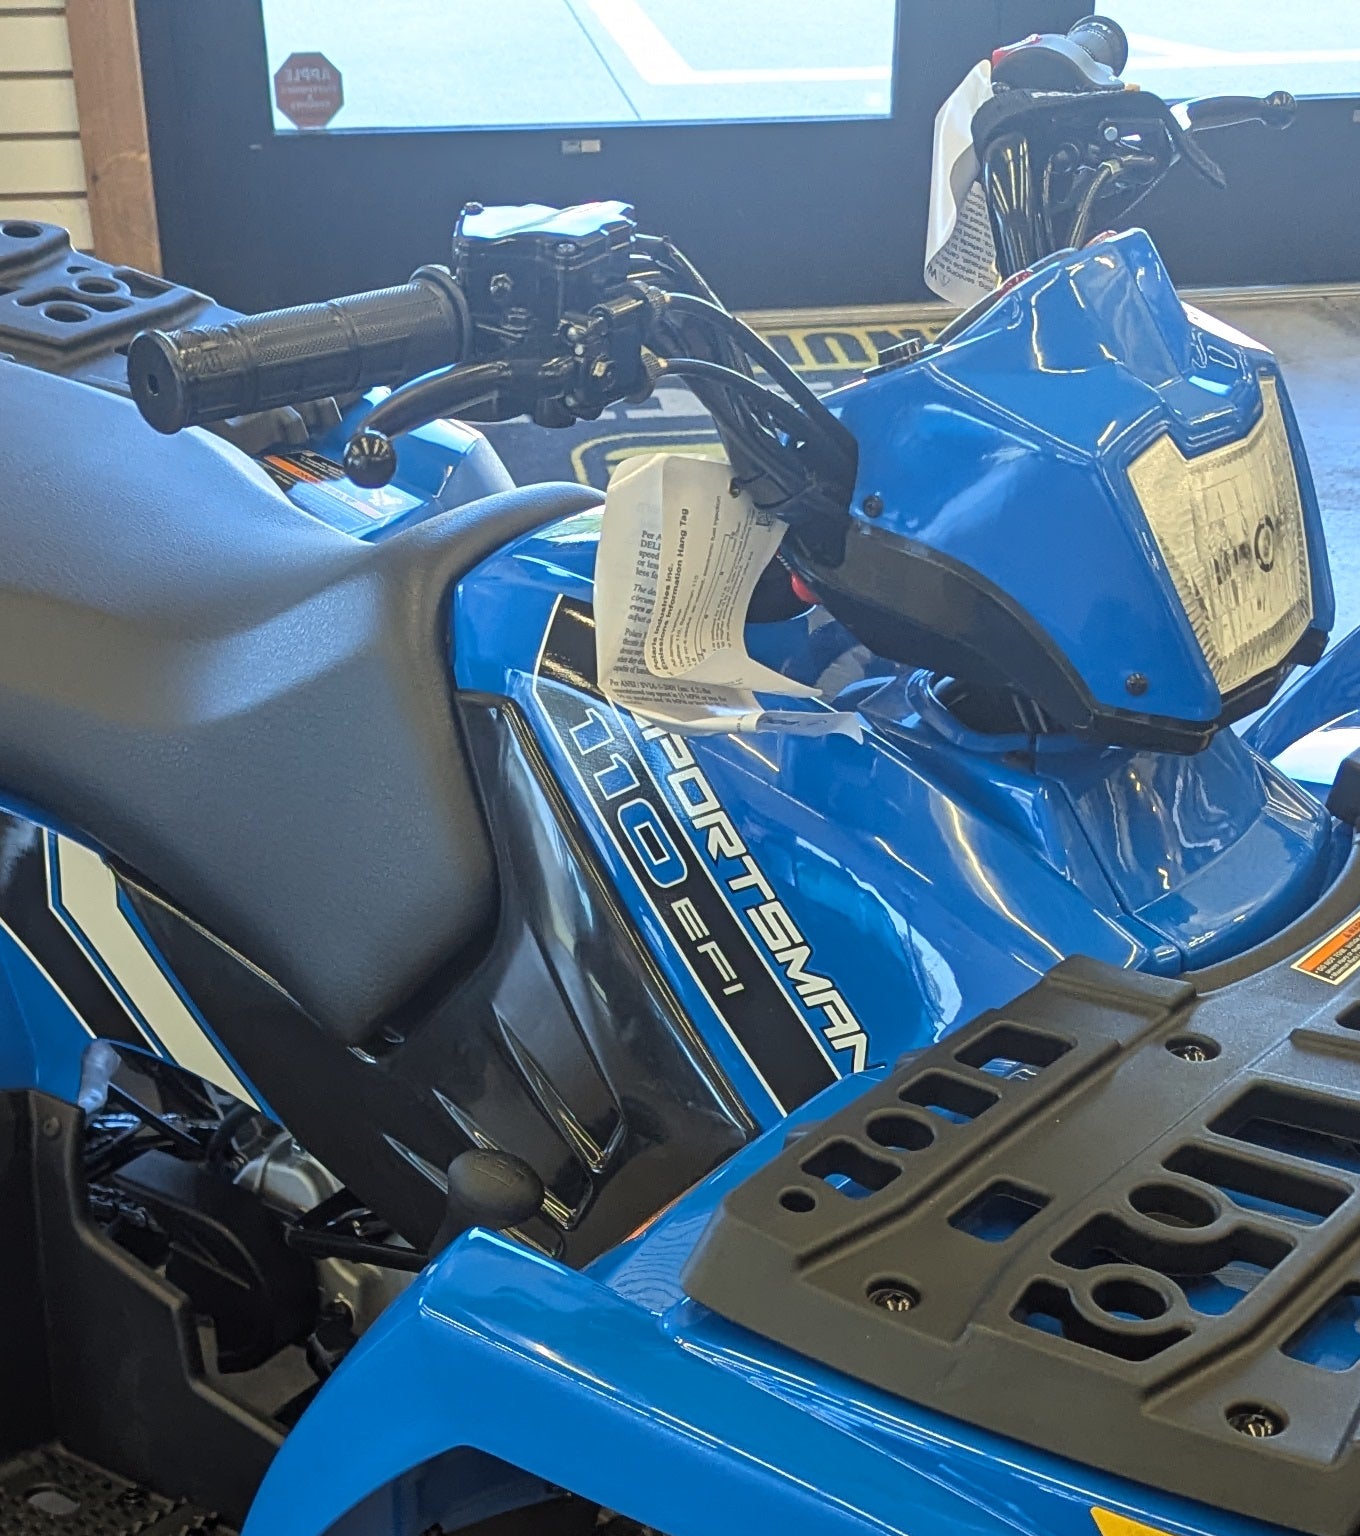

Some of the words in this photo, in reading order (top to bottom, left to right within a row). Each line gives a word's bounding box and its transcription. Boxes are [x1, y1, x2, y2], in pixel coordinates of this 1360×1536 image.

[679, 508, 689, 526] Tag
[677, 530, 688, 557] Hang
[665, 563, 674, 582] Inc.
[666, 559, 683, 618] Information
[654, 584, 671, 634] Industries
[651, 637, 661, 670] Polaris
[658, 620, 669, 670] Emissions
[569, 707, 689, 889] 110
[670, 896, 745, 997] EFI
[631, 711, 868, 1074] PORTSMAN
